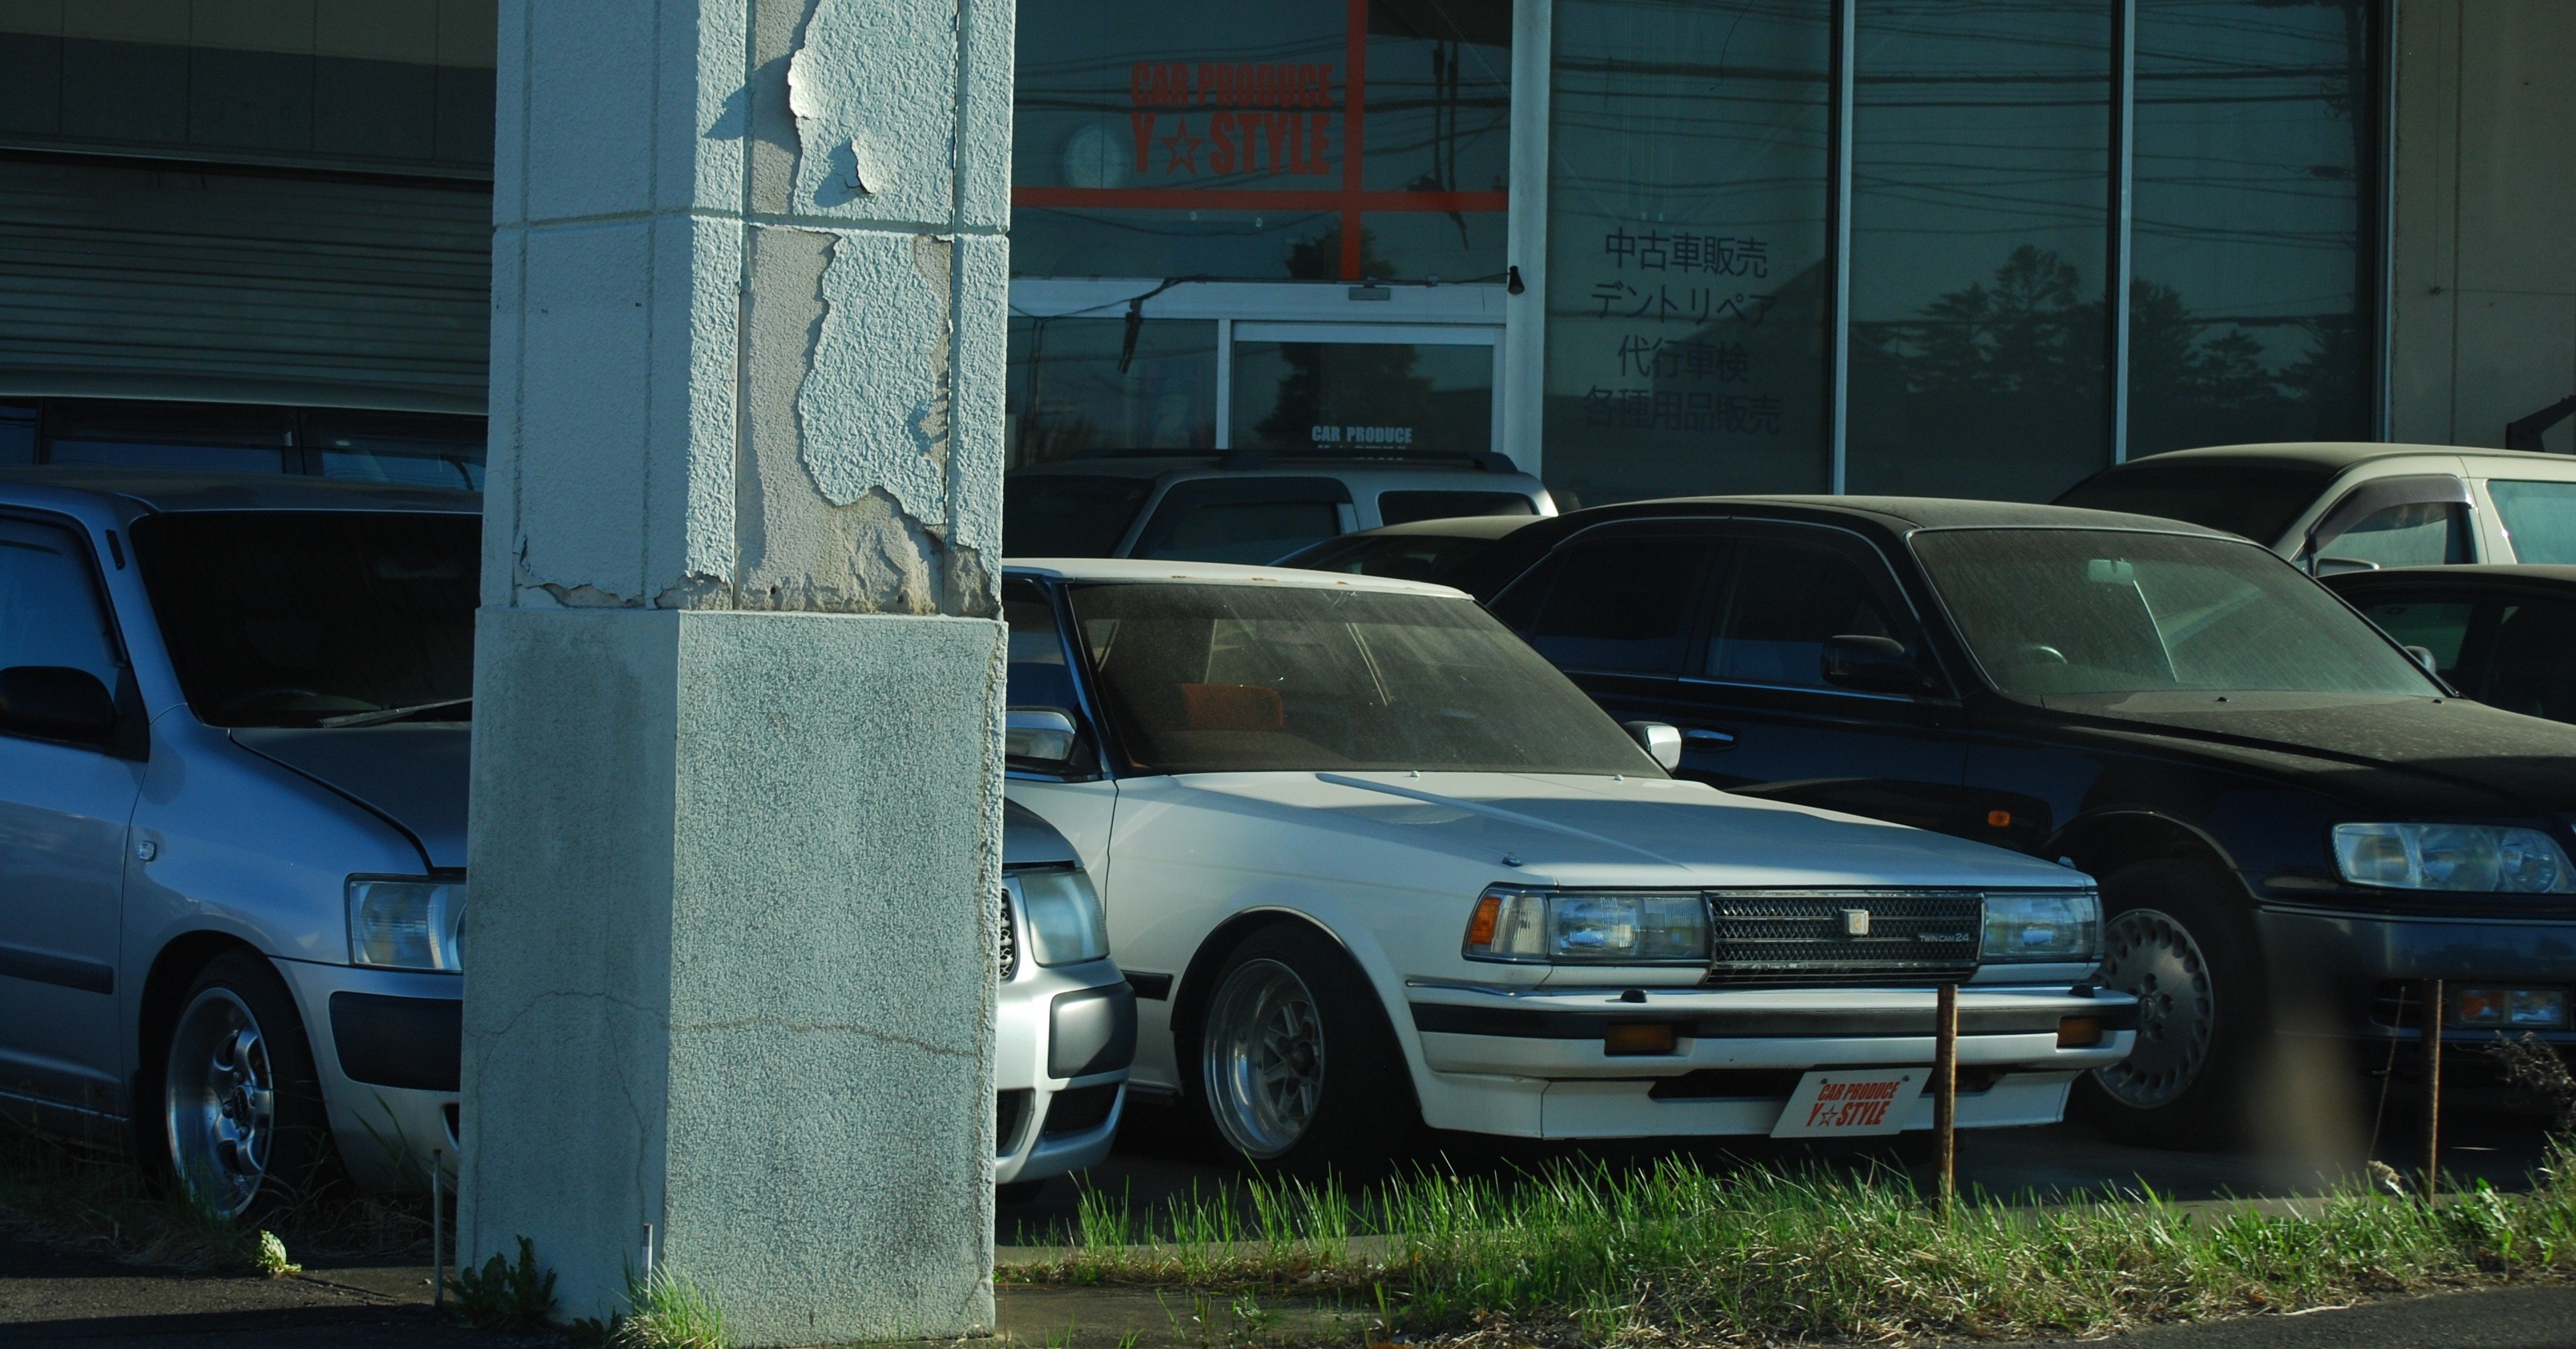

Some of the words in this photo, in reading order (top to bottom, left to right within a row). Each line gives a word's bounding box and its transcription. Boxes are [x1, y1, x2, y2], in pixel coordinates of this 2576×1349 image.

[1132, 61, 1189, 106] CAR
[1198, 63, 1334, 107] PRODUCE
[1605, 226, 1768, 278] 中古車販売
[1591, 280, 1777, 328] デントリペア
[1617, 335, 1749, 383] 代行車検
[1585, 385, 1781, 435] 各種用品販売
[1311, 426, 1340, 442] CAR
[1347, 427, 1412, 443] PRODUCE
[1955, 932, 1969, 942] 24
[1818, 1083, 1846, 1101] CAR
[1842, 1081, 1900, 1100] PRODUCE
